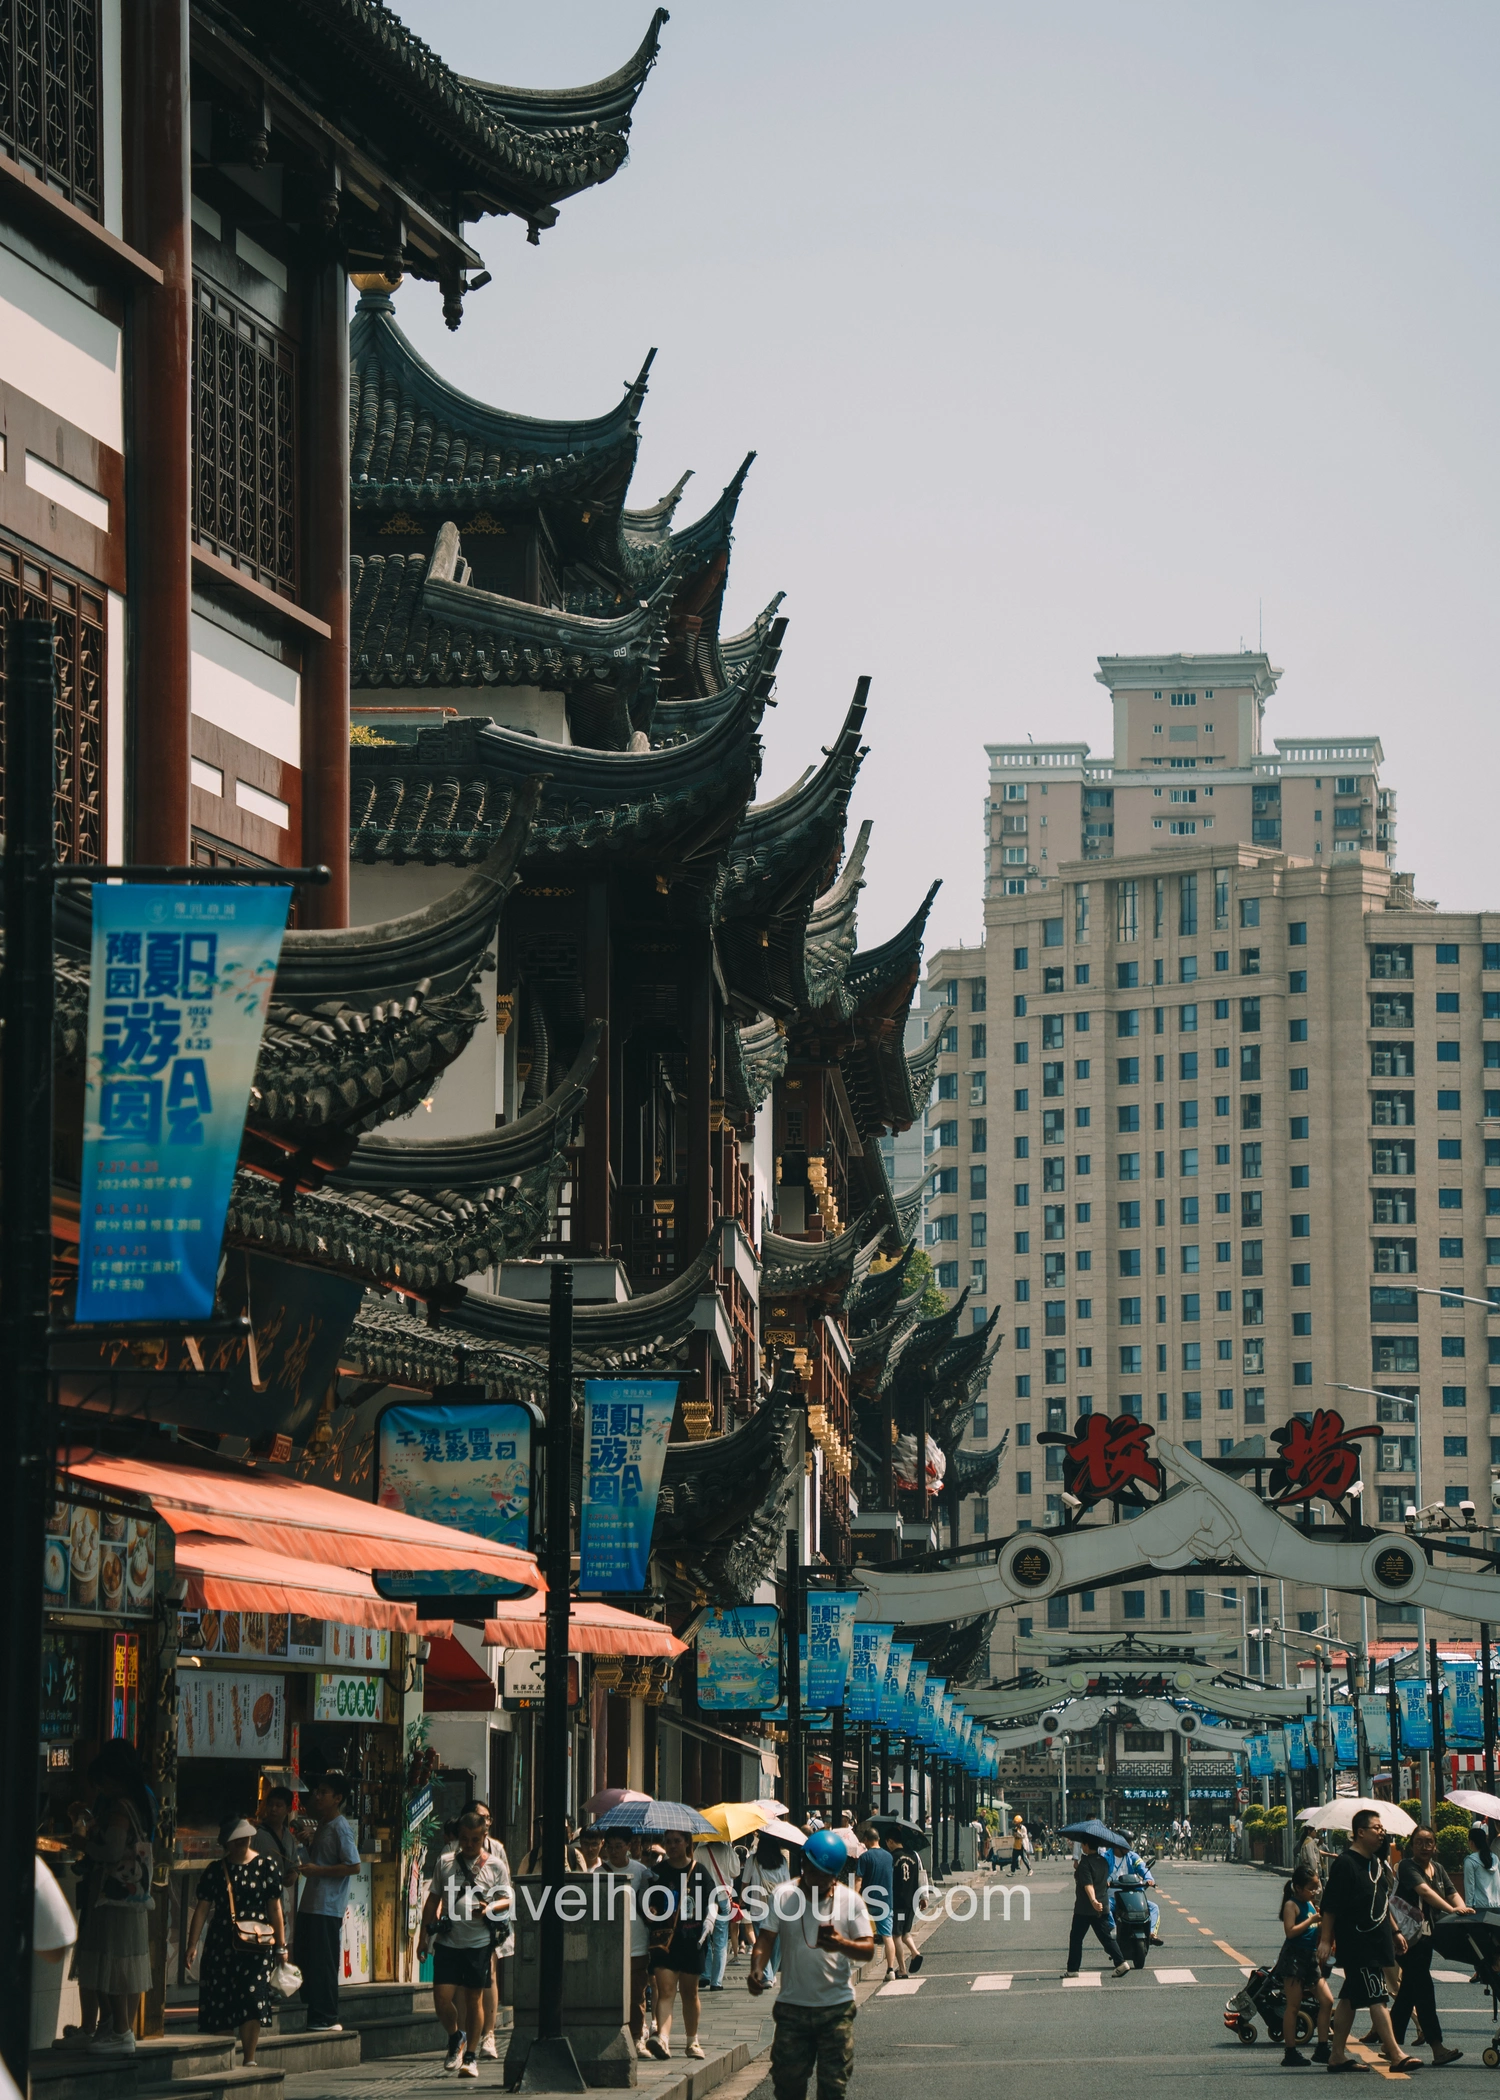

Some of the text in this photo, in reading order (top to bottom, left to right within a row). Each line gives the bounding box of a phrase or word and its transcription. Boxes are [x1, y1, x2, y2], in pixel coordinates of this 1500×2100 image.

[143, 932, 218, 1000] 夏日
[186, 1005, 212, 1015] 2024
[191, 1017, 207, 1029] 7.5
[185, 1039, 212, 1050] 8.25
[609, 1404, 643, 1436] 夏日
[395, 1428, 490, 1446] 千禧乐园
[422, 1441, 516, 1462] 光影夏日
